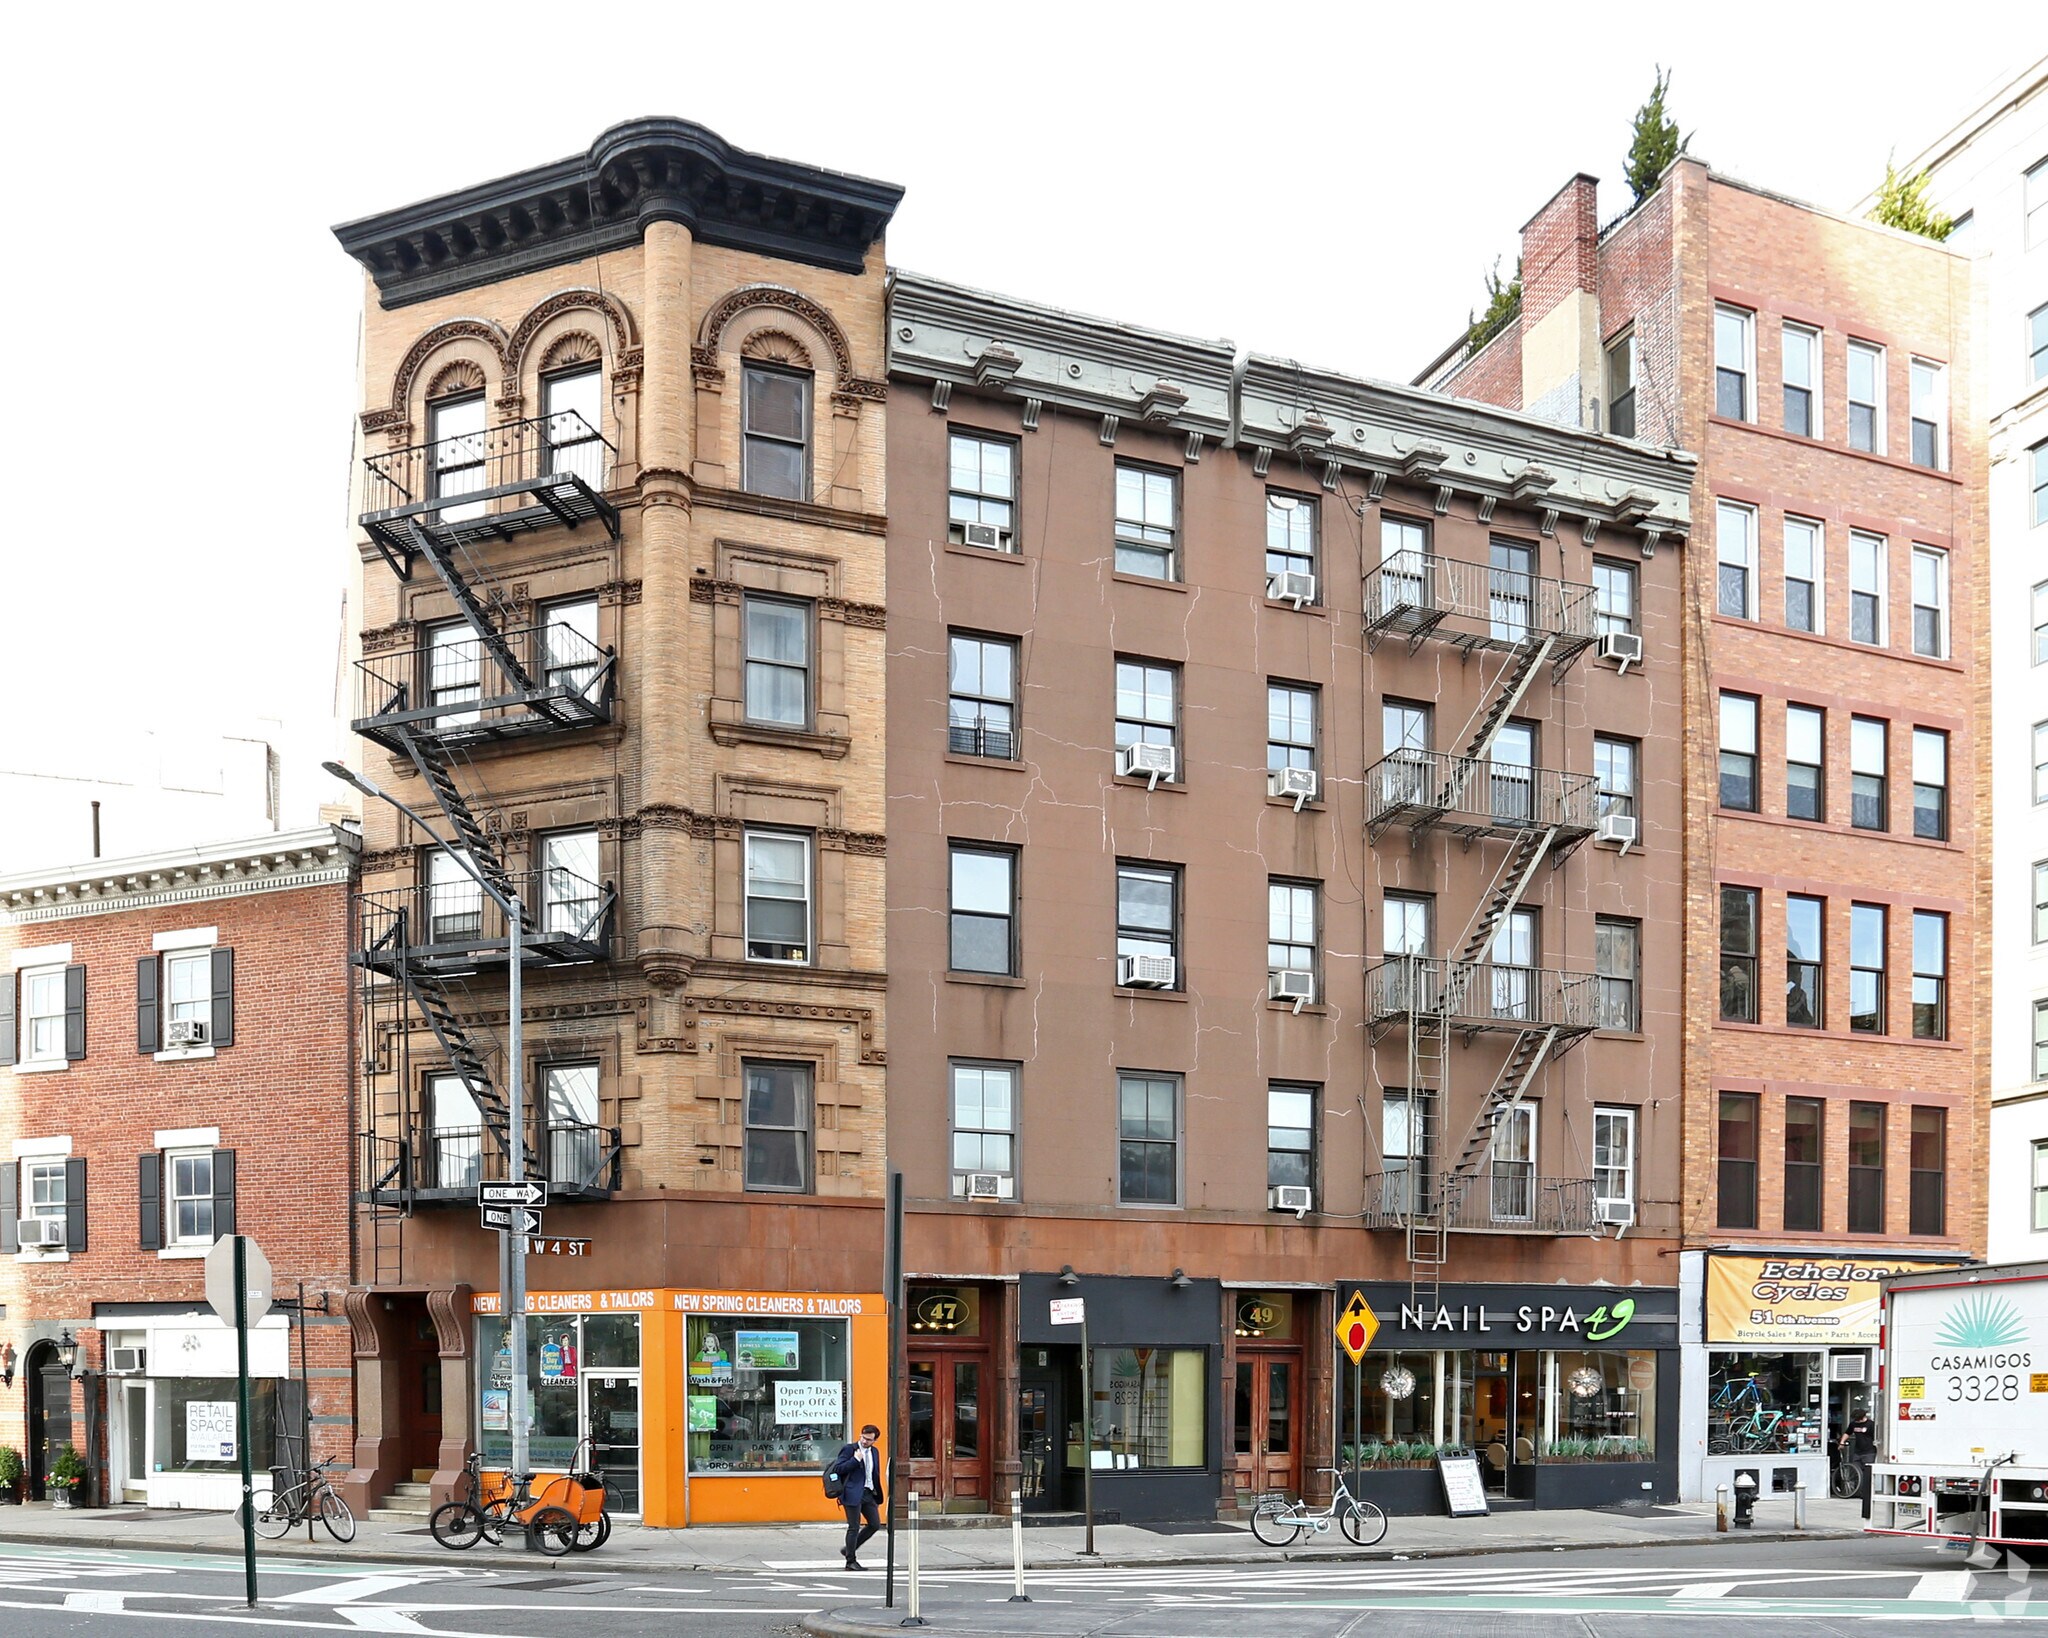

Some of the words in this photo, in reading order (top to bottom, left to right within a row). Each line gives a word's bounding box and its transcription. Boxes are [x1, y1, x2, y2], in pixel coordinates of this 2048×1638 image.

[488, 1189, 508, 1198] ONE
[516, 1189, 536, 1198] WAY
[490, 1212, 508, 1223] ONE
[534, 1240, 546, 1254] W
[551, 1241, 561, 1255] 4
[568, 1242, 585, 1256] ST
[1752, 1281, 1849, 1304] Cycles
[473, 1297, 496, 1311] NEW
[538, 1294, 592, 1310] CLEANERS
[600, 1293, 608, 1308] &
[610, 1291, 655, 1308] TAILORS
[674, 1294, 700, 1310] NEW
[702, 1295, 743, 1312] SPRING
[746, 1297, 804, 1313] CLEANERS
[807, 1299, 815, 1313] &
[817, 1299, 862, 1314] TAILORS
[930, 1303, 957, 1320] 47
[1250, 1307, 1273, 1323] 49
[1750, 1310, 1774, 1324] 51
[1776, 1315, 1795, 1325] 8th
[1797, 1316, 1840, 1325] Avenue
[1401, 1302, 1491, 1331] NAIL
[1516, 1305, 1579, 1332] SPA
[1583, 1298, 1635, 1341] 49
[1737, 1330, 1765, 1338] Bicycle
[1795, 1331, 1823, 1339] Repairs
[1931, 1353, 2032, 1371] CASAMIGOS
[491, 1373, 513, 1381] Altera
[541, 1377, 578, 1386] CLEANERS
[500, 1381, 512, 1390] Rep
[605, 1379, 615, 1388] 45
[1947, 1374, 2019, 1402] 3328
[780, 1387, 805, 1396] Open
[807, 1386, 813, 1394] 7
[815, 1387, 838, 1396] Days
[780, 1398, 805, 1407] Drop
[808, 1398, 826, 1406] Off
[828, 1398, 837, 1406] &
[190, 1404, 234, 1418] RETAIL
[780, 1409, 838, 1418] Self-Service
[190, 1419, 234, 1432] SPACE
[190, 1433, 234, 1441] AVAILABLE
[709, 1444, 733, 1452] OPEN
